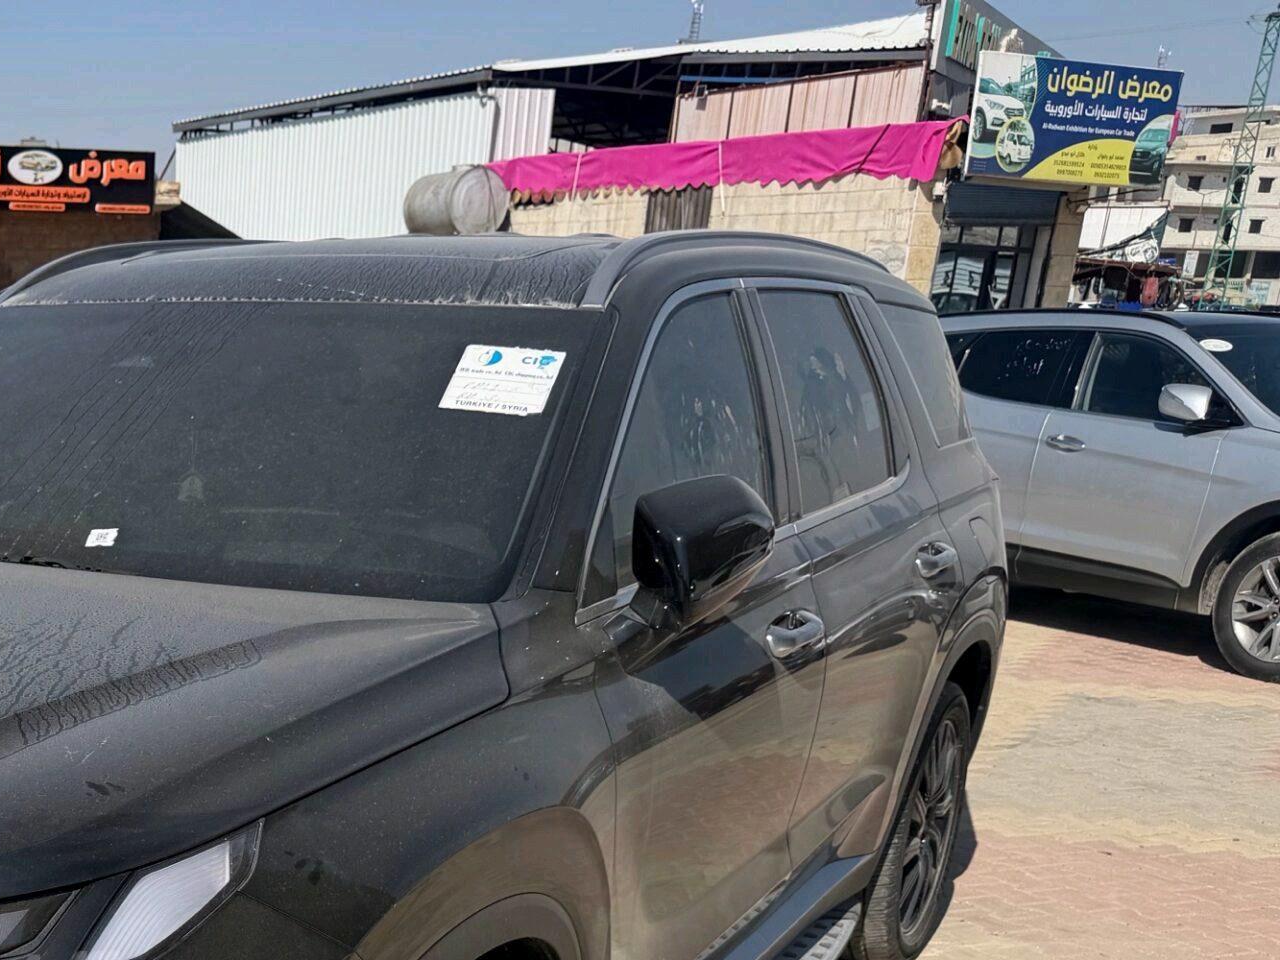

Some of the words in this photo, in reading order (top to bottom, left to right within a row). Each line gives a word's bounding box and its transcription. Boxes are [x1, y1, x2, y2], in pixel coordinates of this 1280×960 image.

[1047, 66, 1115, 99] الرضوان
[1118, 75, 1172, 103] معرض
[1044, 100, 1084, 118] الأوروبية
[1084, 104, 1122, 121] السيارات
[1123, 107, 1148, 123] لتجارة
[1066, 124, 1088, 134] Exhibition
[1095, 127, 1115, 137] European
[1123, 130, 1135, 138] Trade
[68, 151, 146, 187] معرض
[501, 404, 529, 413] SYRIA
